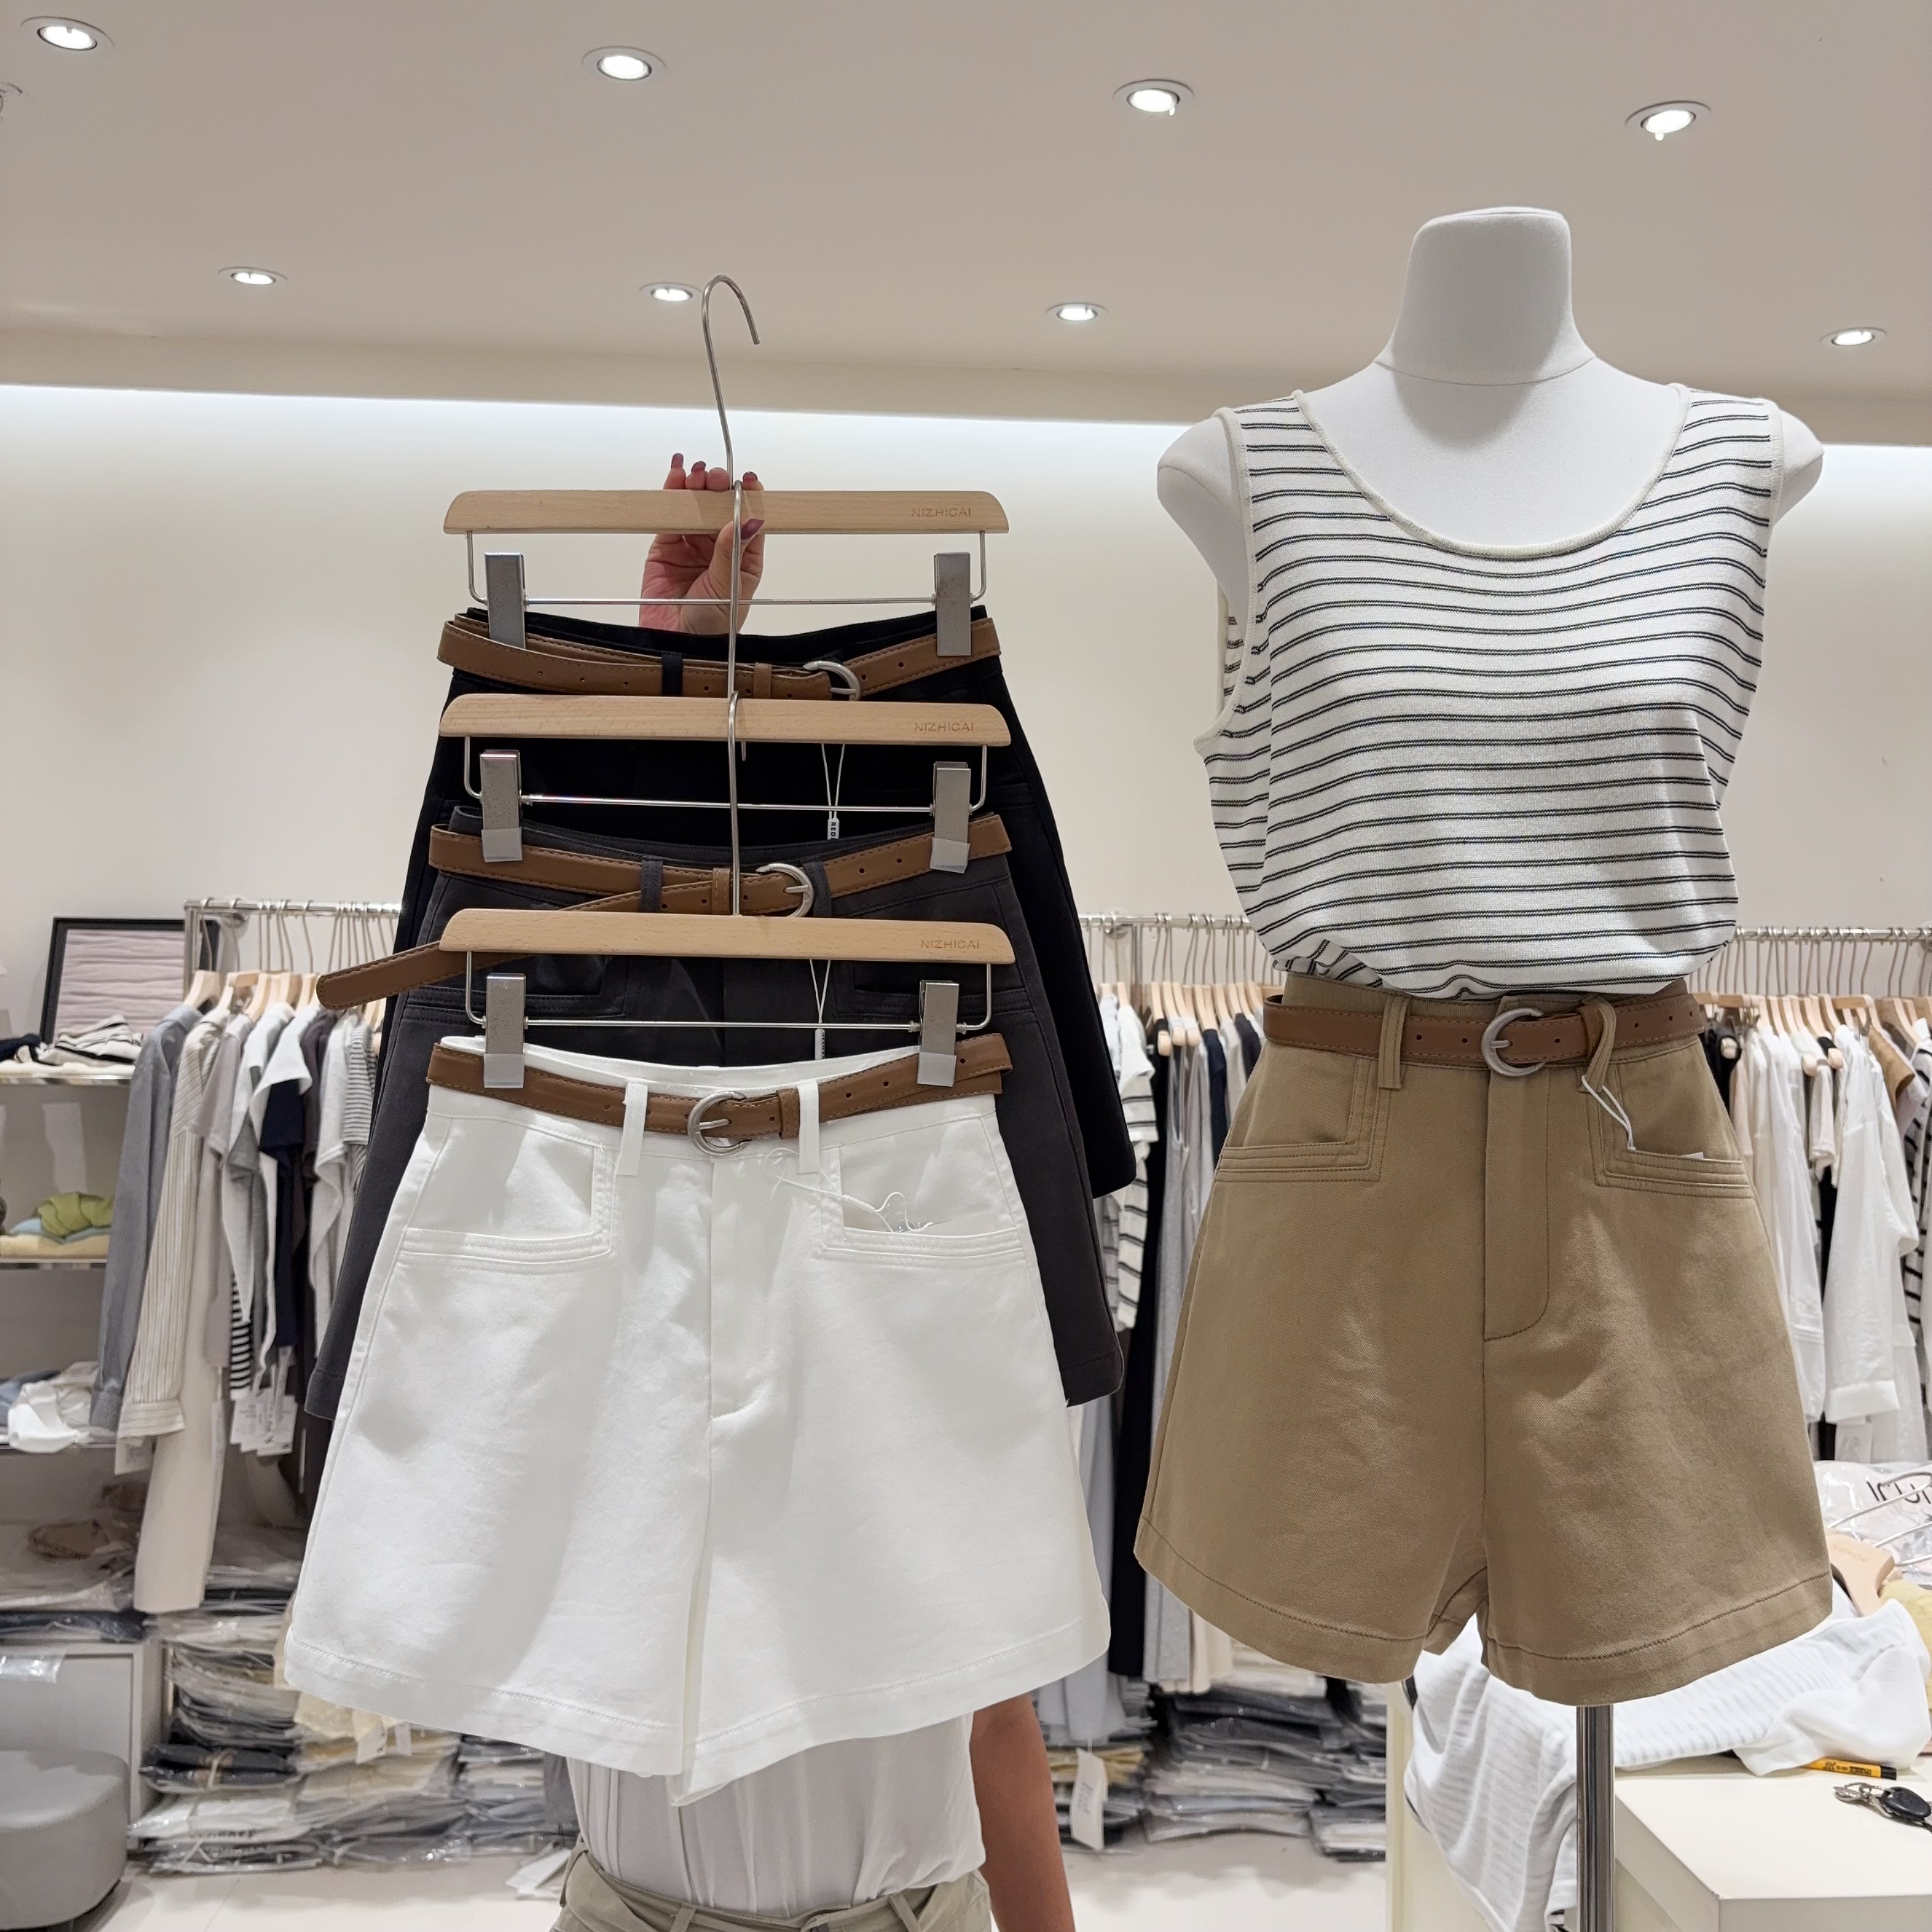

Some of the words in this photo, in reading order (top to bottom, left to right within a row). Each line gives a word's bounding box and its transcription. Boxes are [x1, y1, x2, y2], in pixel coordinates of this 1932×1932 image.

[912, 507, 971, 518] NIZHICAI
[914, 722, 974, 732] NIZHICAI
[920, 939, 979, 949] NIZHICAI
